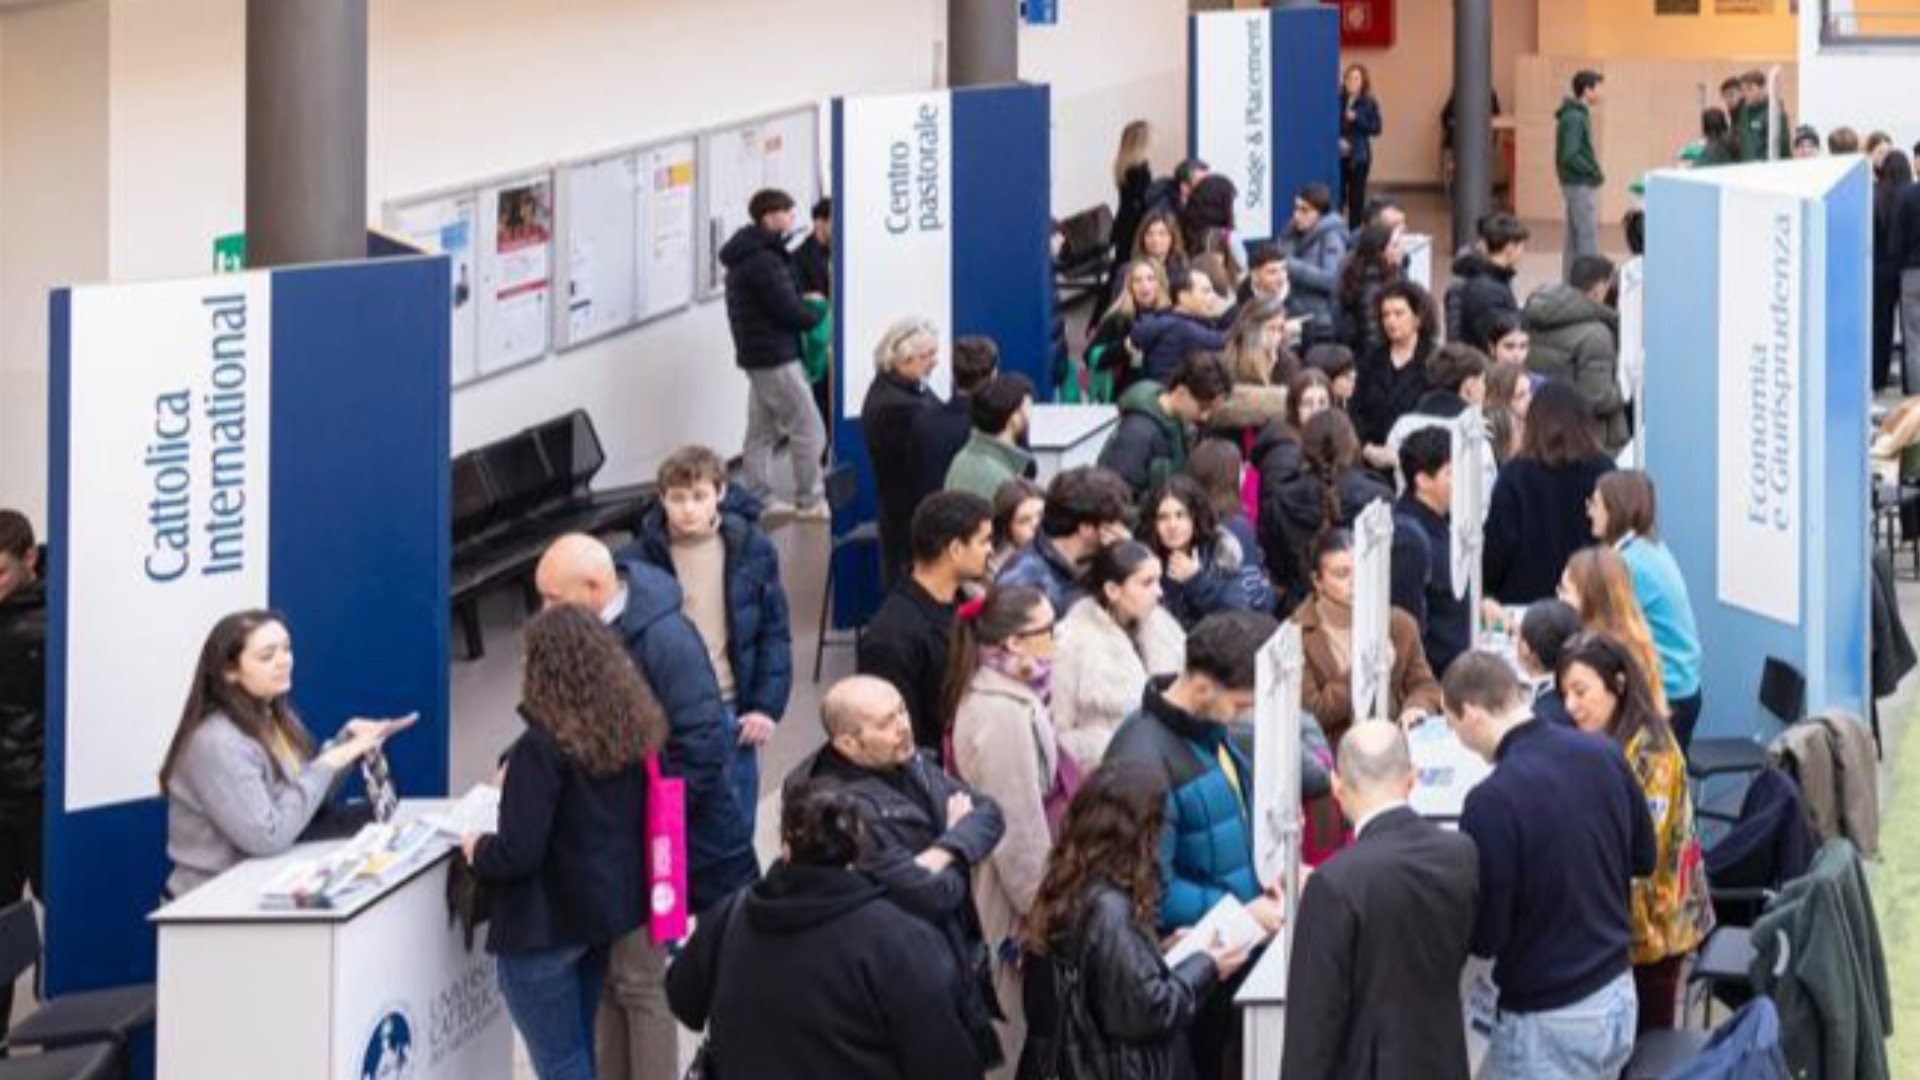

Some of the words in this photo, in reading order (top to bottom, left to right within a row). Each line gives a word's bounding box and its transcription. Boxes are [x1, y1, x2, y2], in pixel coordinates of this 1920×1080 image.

[1244, 19, 1263, 126] Placement
[884, 140, 911, 235] Centro
[913, 102, 944, 232] pastorale
[1245, 150, 1265, 209] Stage
[1246, 130, 1264, 146] &
[1770, 213, 1793, 495] Giurisprudenza
[144, 387, 191, 583] Cattolica
[201, 292, 247, 576] International
[1748, 343, 1769, 526] Economia
[1774, 507, 1789, 531] e
